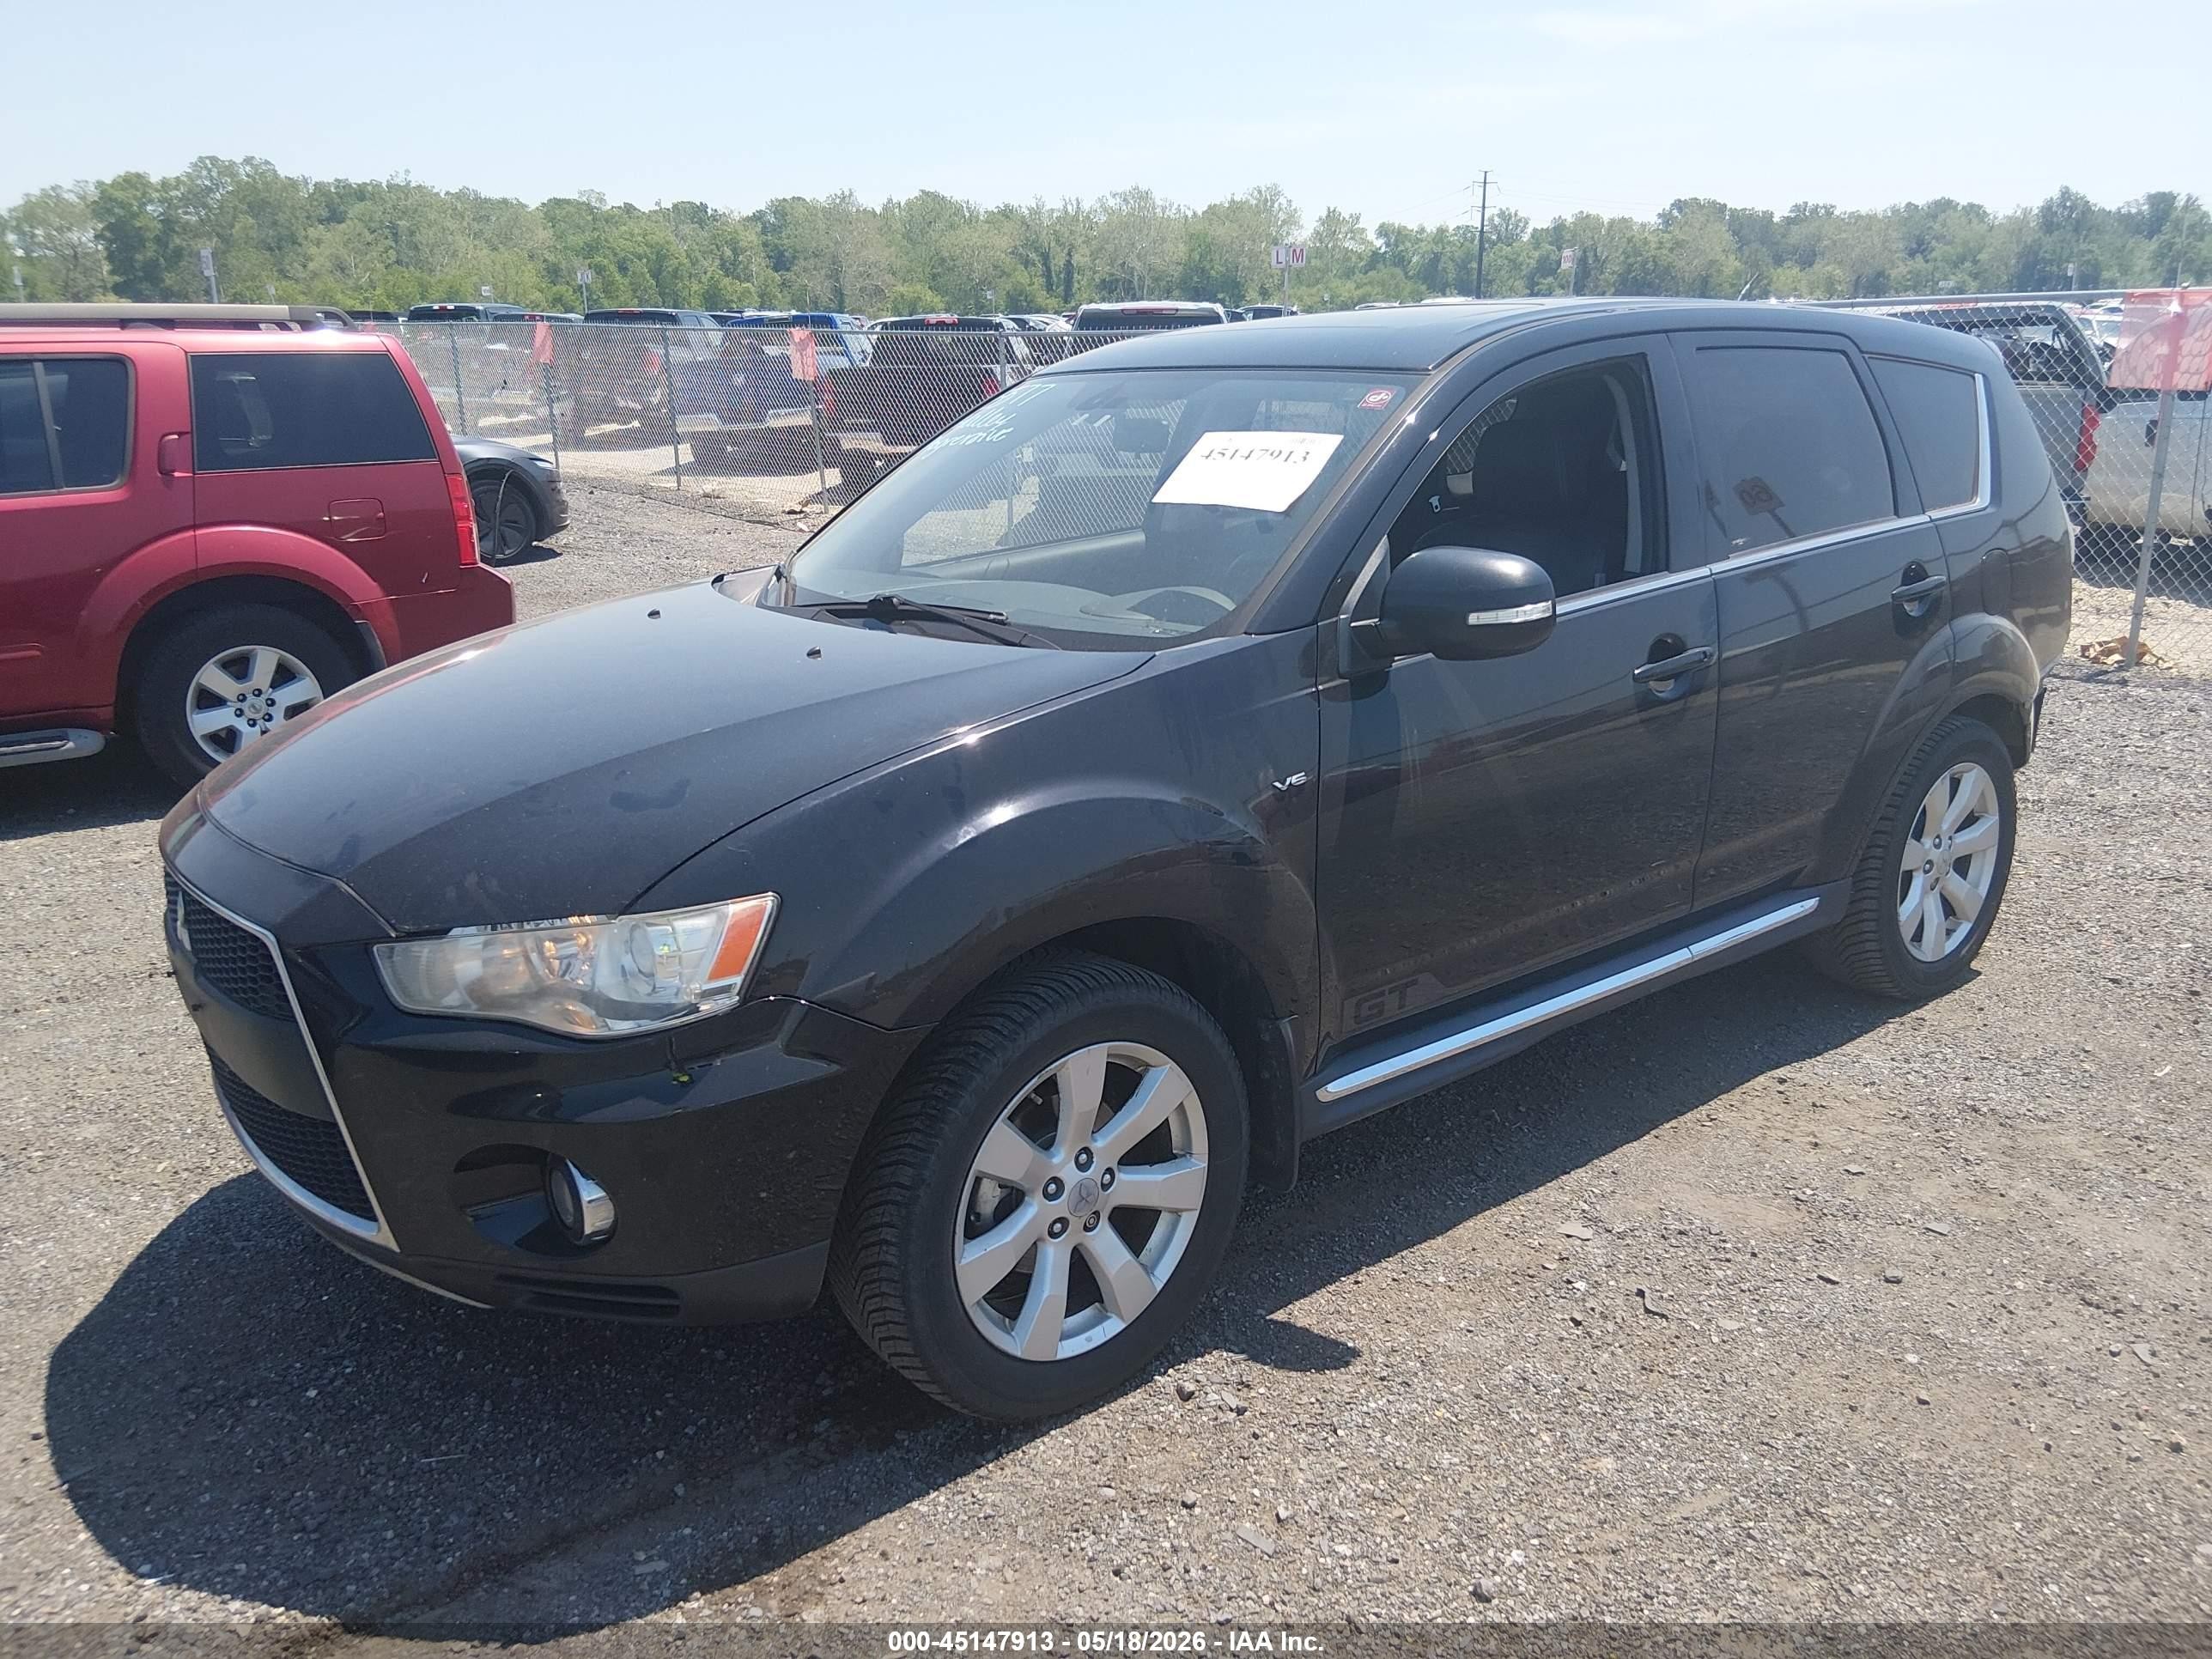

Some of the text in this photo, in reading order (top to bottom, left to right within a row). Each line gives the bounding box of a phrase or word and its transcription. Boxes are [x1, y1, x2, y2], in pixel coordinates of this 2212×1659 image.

[1276, 249, 1283, 264] L
[1291, 247, 1304, 264] M
[1200, 447, 1311, 465] 45147913
[1272, 771, 1308, 791] V6
[1354, 977, 1419, 1025] GT
